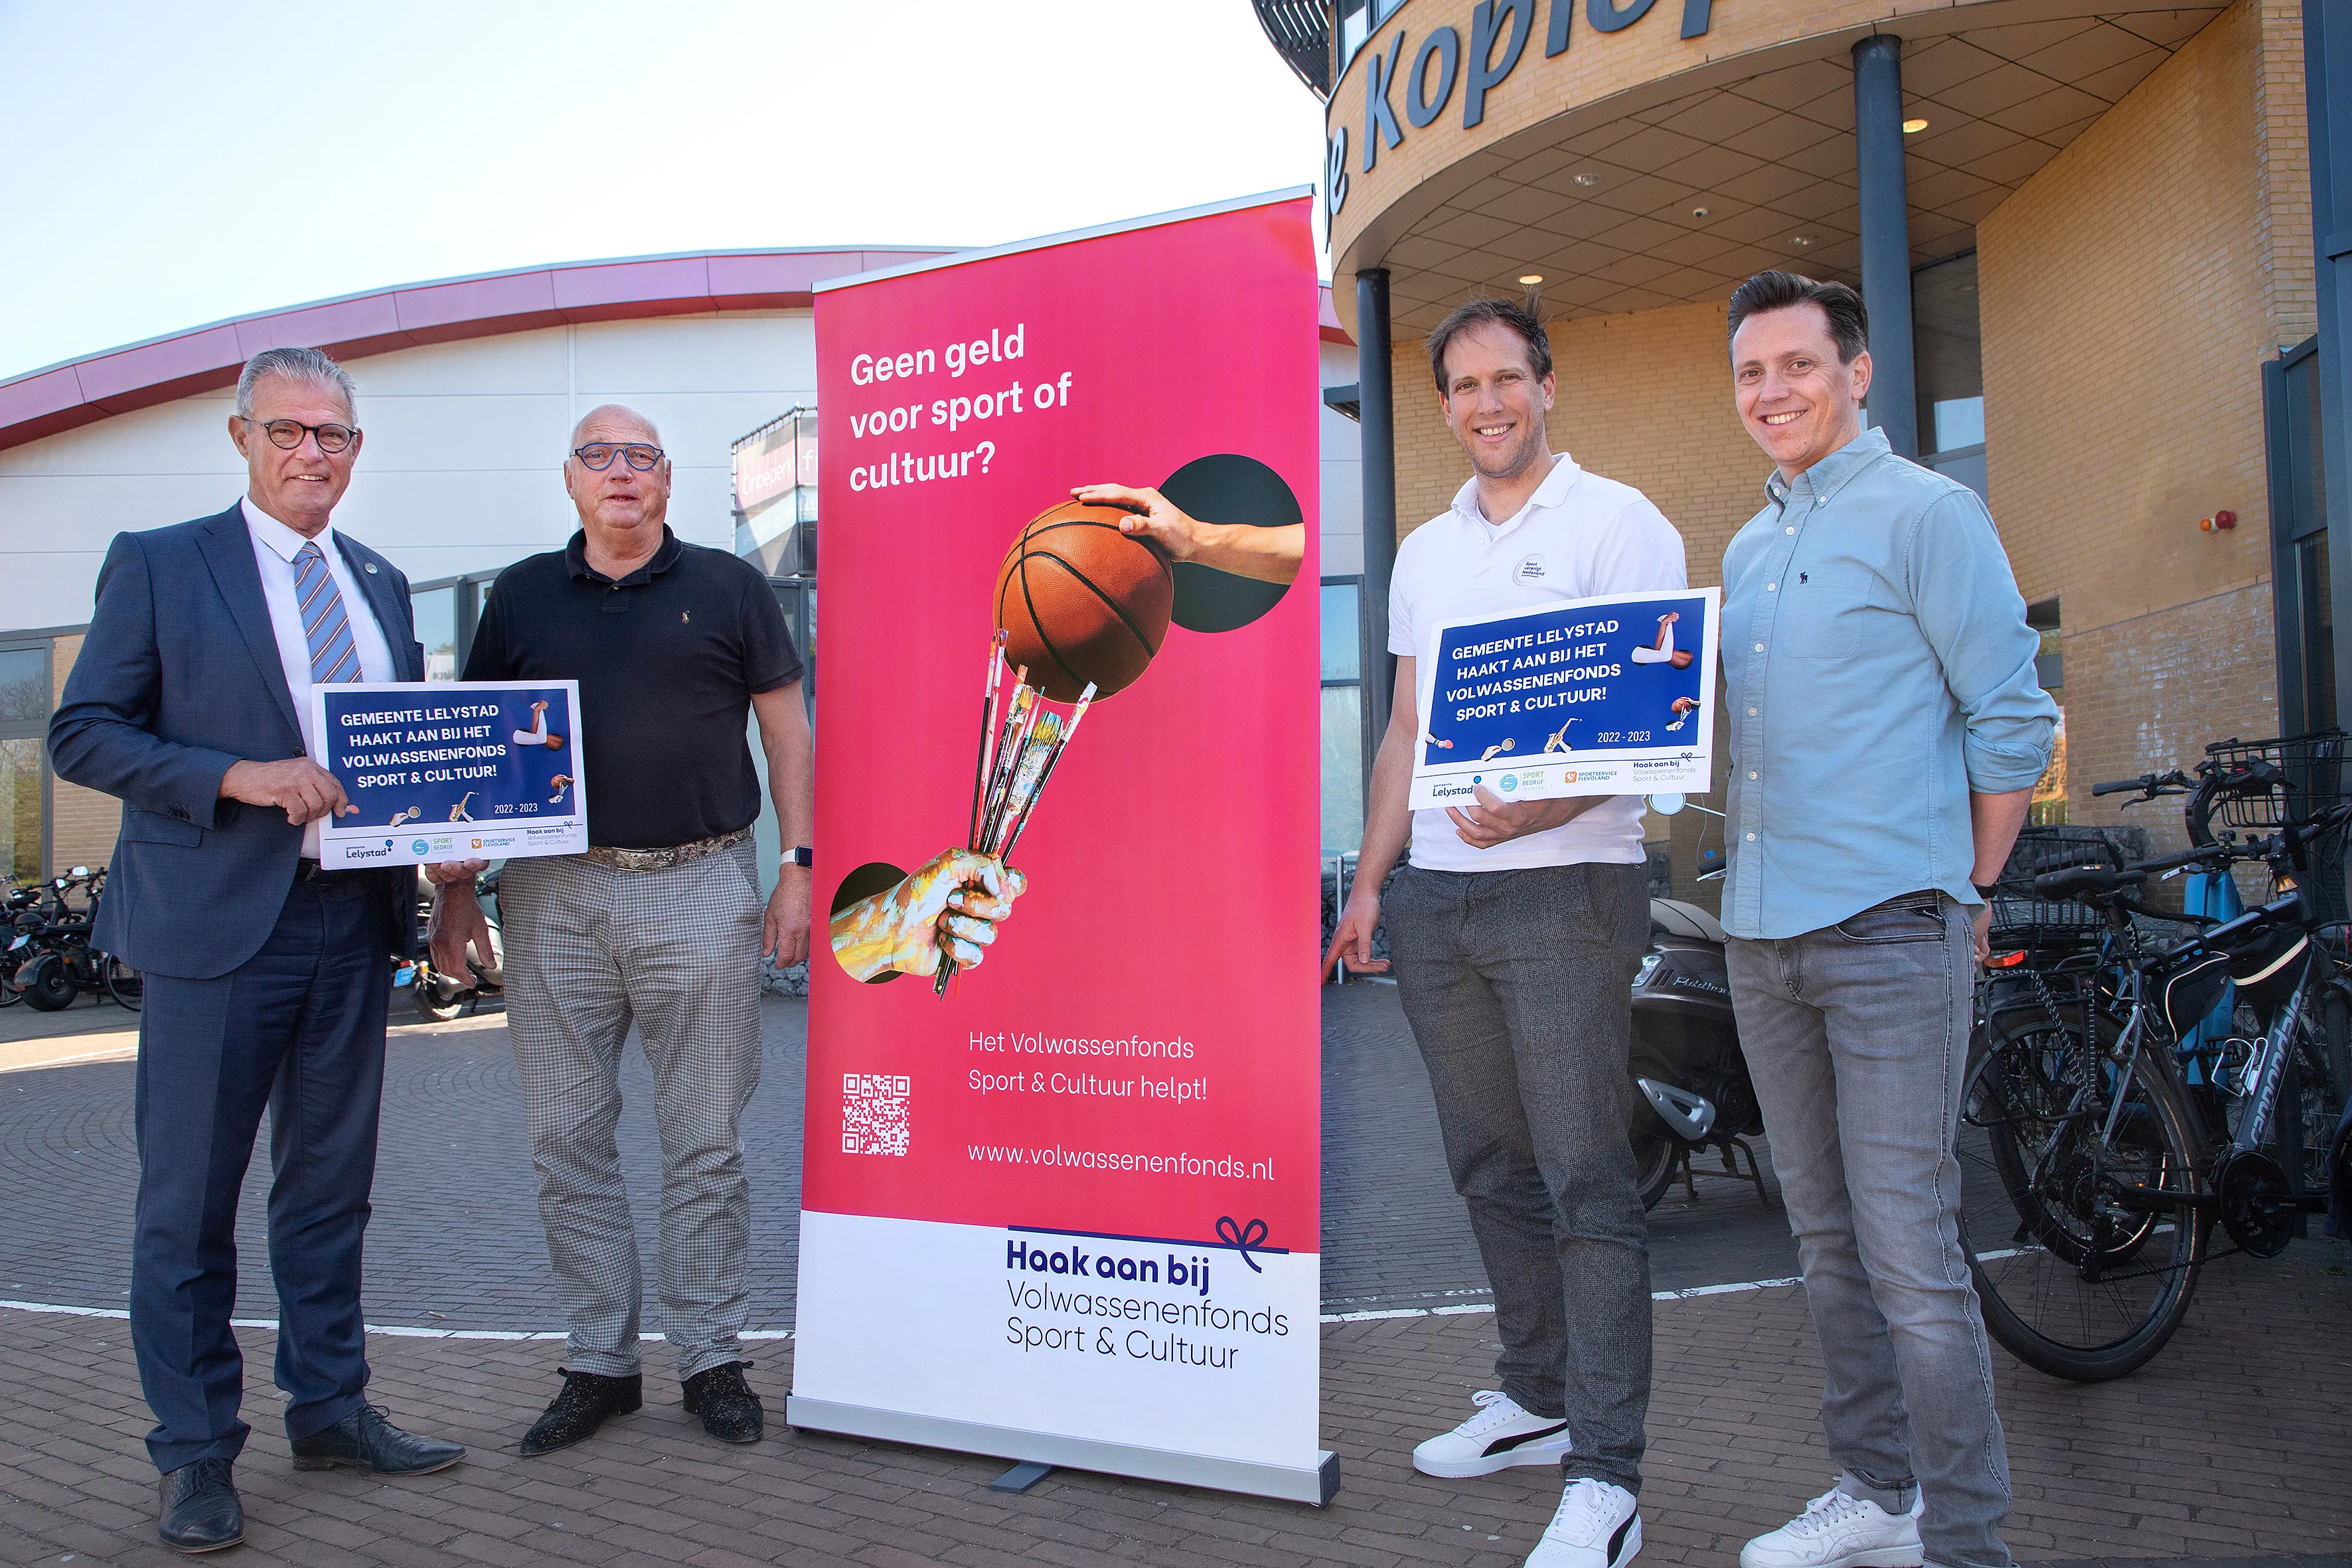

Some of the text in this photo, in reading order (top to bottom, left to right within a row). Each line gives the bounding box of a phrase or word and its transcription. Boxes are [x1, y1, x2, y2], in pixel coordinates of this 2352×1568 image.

[850, 323, 1026, 386] Geen geld
[849, 371, 1073, 439] voor sport of
[849, 440, 996, 492] cultuur?
[1452, 619, 1620, 661] GEMEENTE LELYSTAD
[1456, 643, 1607, 680] HAAKT AAN BIJ HET
[1446, 663, 1621, 703] VOLWASSENENFONDS
[341, 704, 499, 726] GEMEENTE LELYSTAD
[1456, 686, 1607, 722] SPORT & CULTUUR!
[349, 725, 491, 747] HAAKT AAN BIJ HET
[1597, 732, 1618, 744] 2022
[1628, 730, 1651, 742] 2023
[342, 744, 507, 769] VOLWASSENENFONDS
[357, 764, 497, 789] SPORT & CULTUUR!
[1433, 785, 1474, 797] Lelystad
[1523, 771, 1545, 779] SPORT
[494, 804, 512, 814] 2022
[519, 803, 538, 813] 2023
[346, 848, 387, 859] Lelystad
[527, 832, 578, 841] Volwassenenfonds
[969, 1030, 1195, 1059] Het Volwassenfonds
[2250, 990, 2302, 1146] cannondale
[968, 1069, 1208, 1105] Sport & Cultuur helpt!
[967, 1143, 1275, 1182] www.volwassenenfonds.nl
[1006, 1239, 1210, 1296] Haak aan bij
[1006, 1279, 1290, 1338] Volwassenenfonds
[1006, 1316, 1239, 1370] Sport & Cultuur
